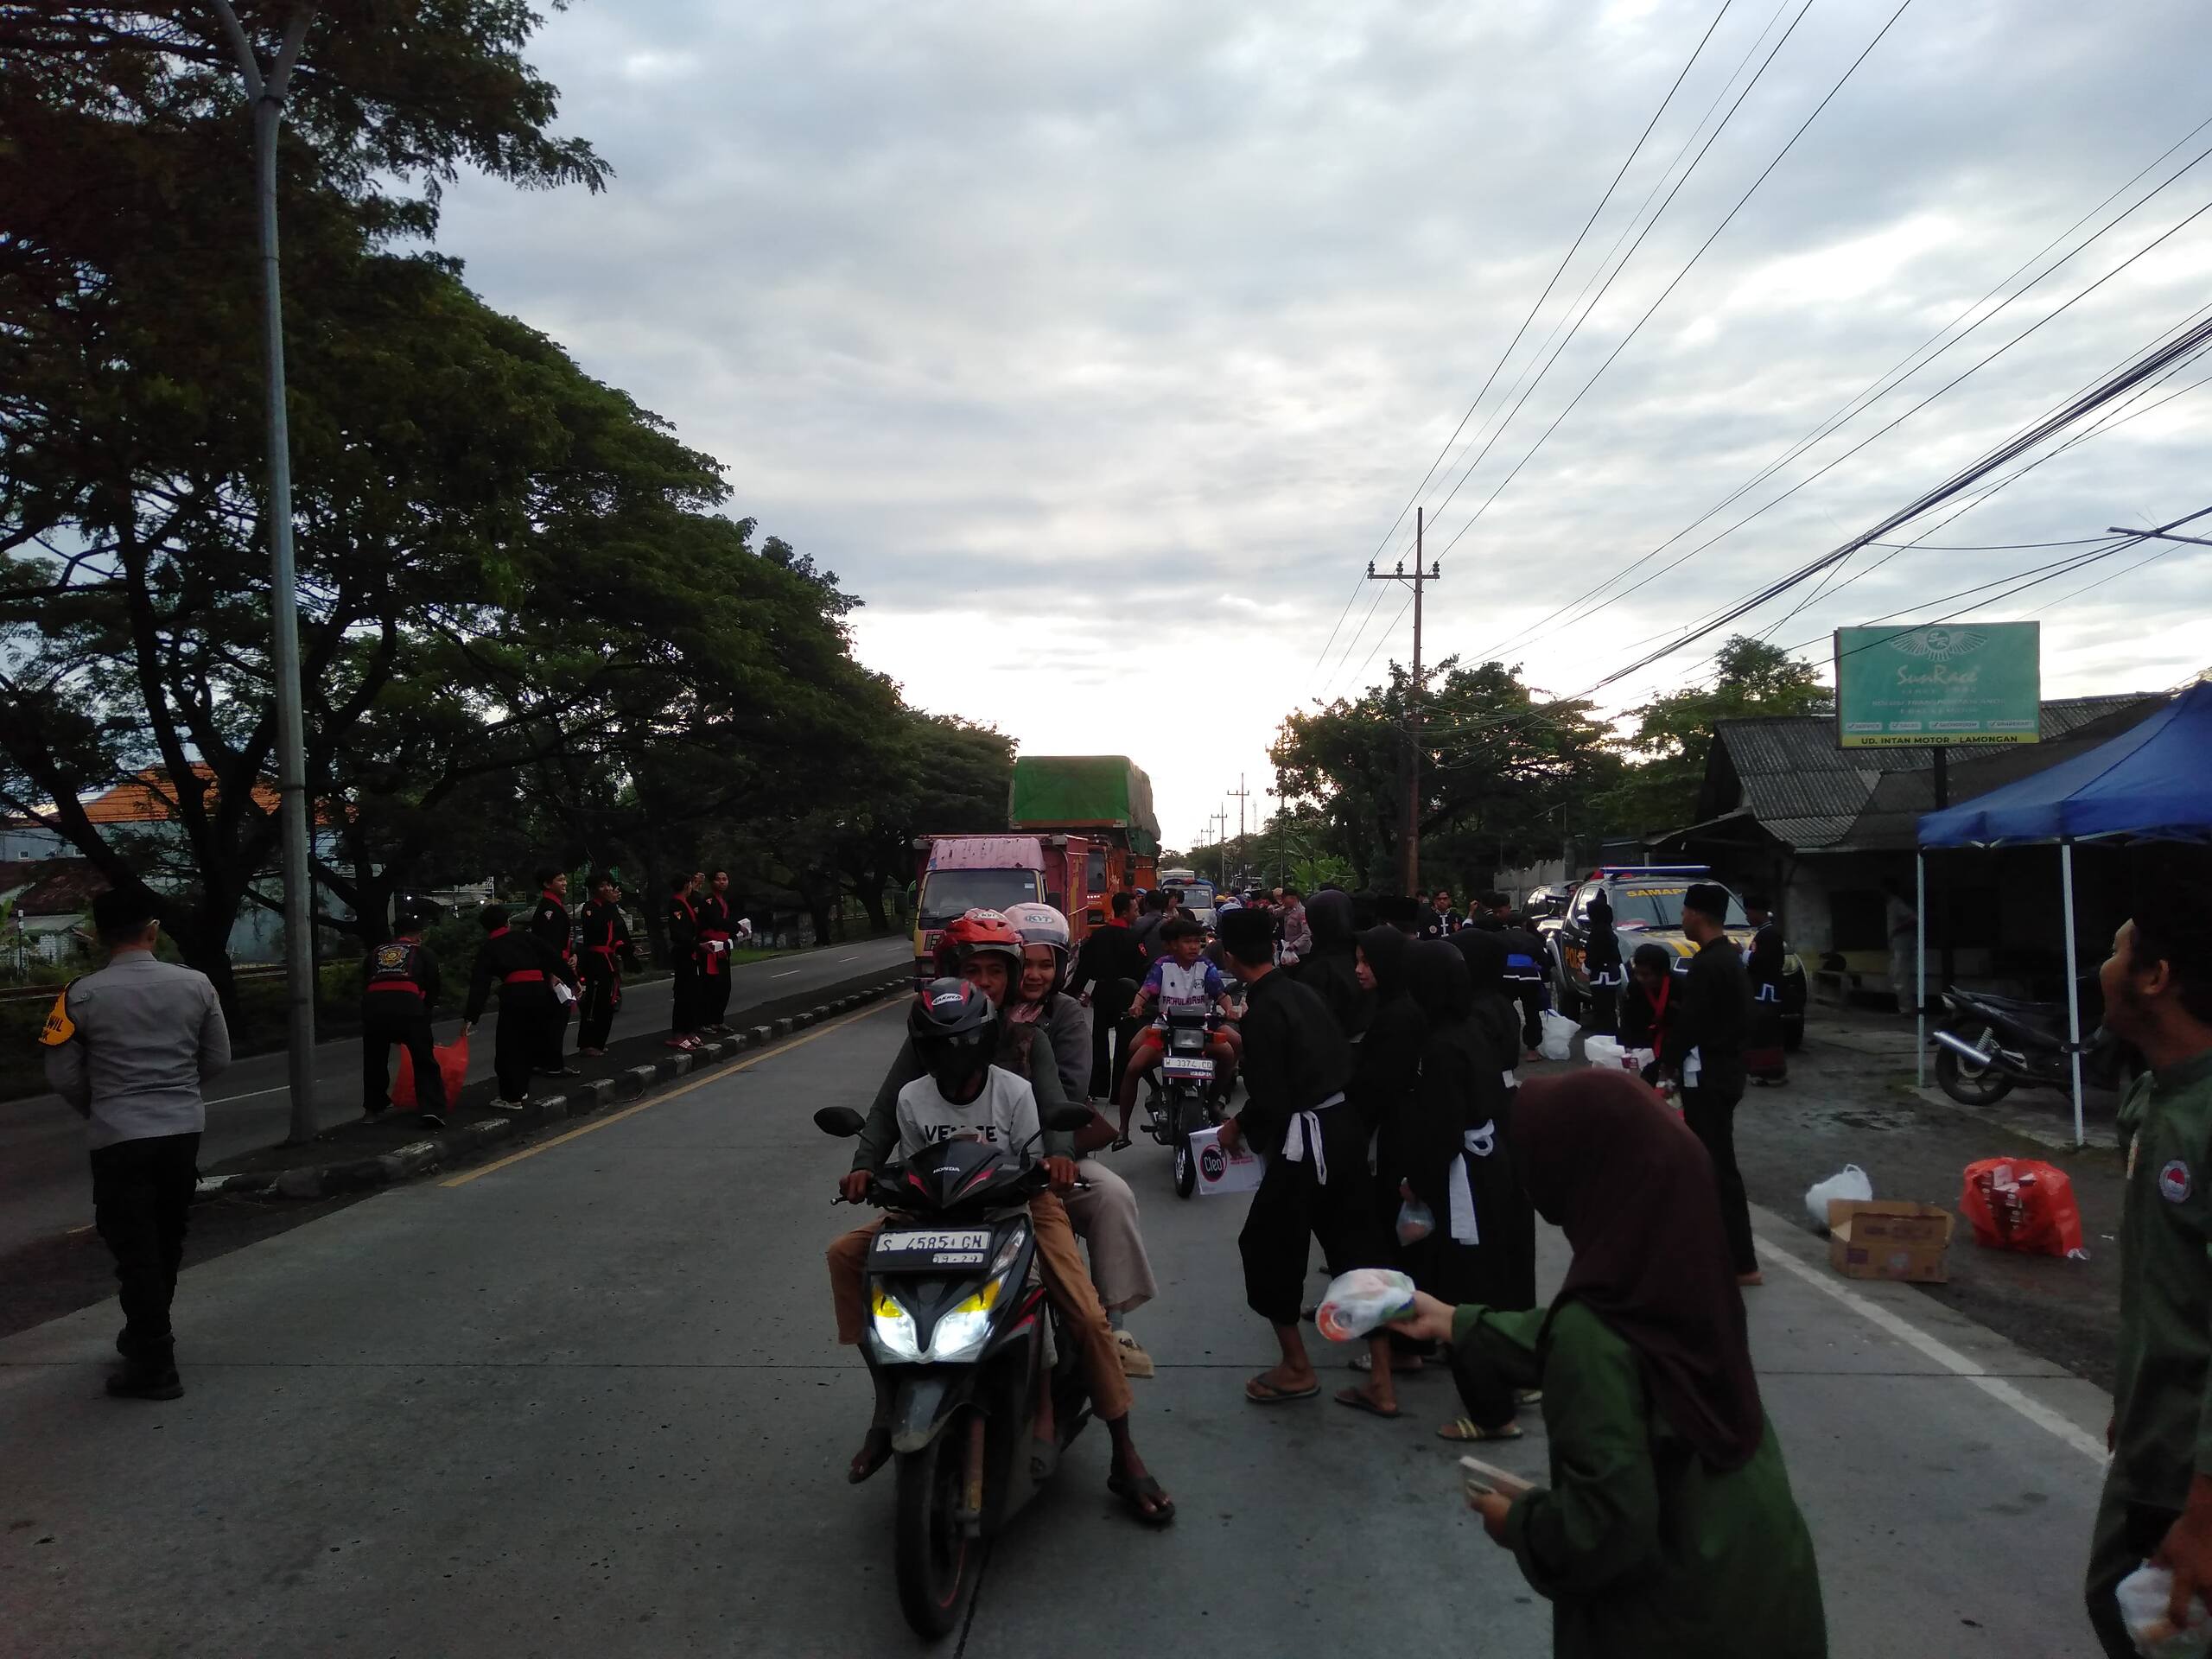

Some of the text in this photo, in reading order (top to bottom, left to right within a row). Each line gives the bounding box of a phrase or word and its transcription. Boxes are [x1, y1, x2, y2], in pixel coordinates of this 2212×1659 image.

[1959, 735, 2018, 744] LAMONGAN
[1204, 1155, 1223, 1173] Cleo
[883, 1238, 893, 1250] S
